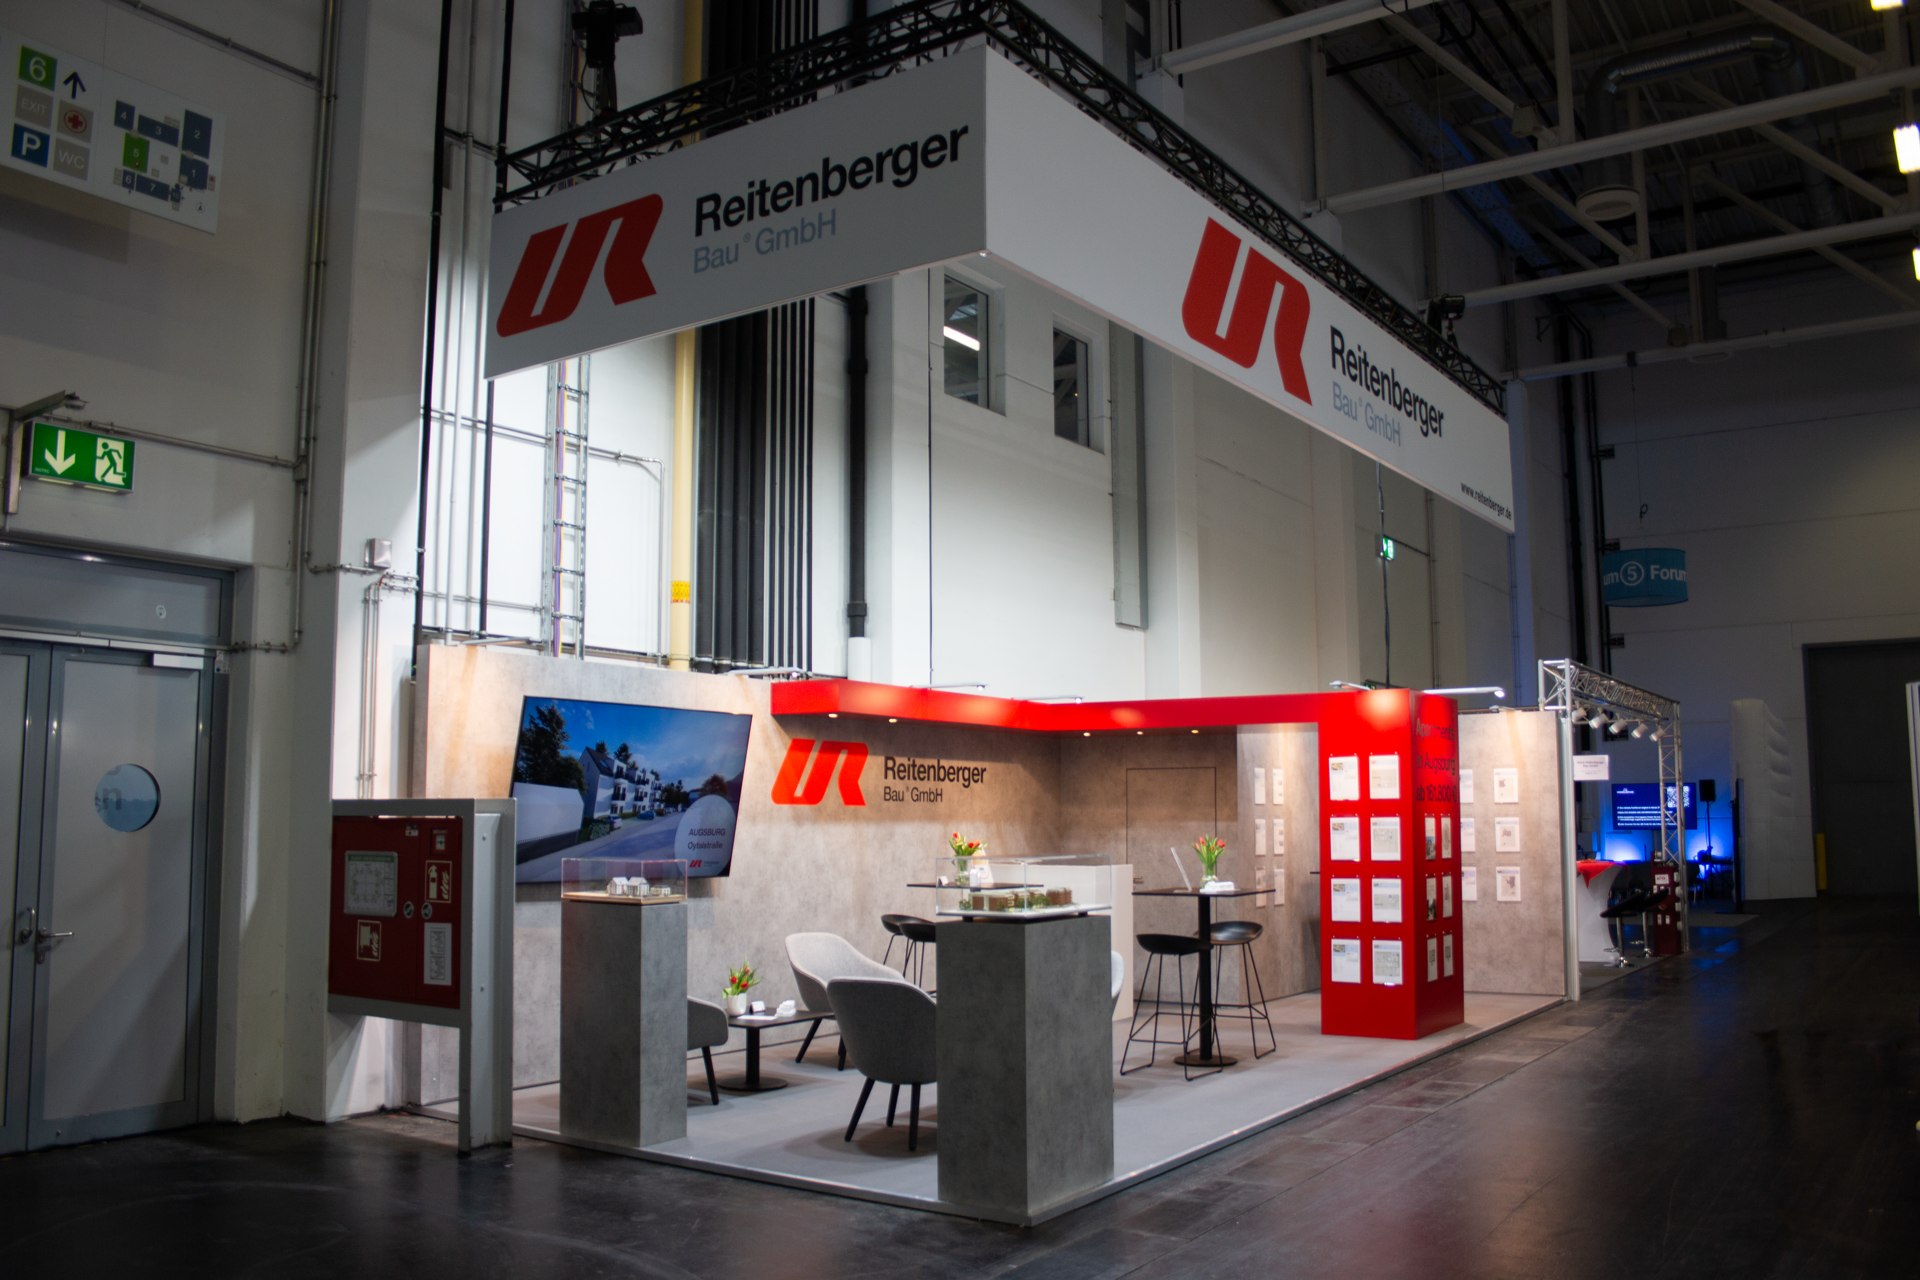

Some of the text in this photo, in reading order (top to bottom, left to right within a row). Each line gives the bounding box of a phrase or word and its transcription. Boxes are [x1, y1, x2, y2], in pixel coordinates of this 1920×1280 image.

[29, 57, 47, 82] 6
[21, 96, 48, 116] EXIT
[22, 132, 41, 156] P
[58, 150, 85, 170] WC
[694, 125, 969, 237] Reitenberger
[755, 208, 837, 255] GmbH
[1330, 324, 1444, 438] Reitenberger
[1364, 402, 1401, 447] GmbH
[1460, 482, 1512, 521] www.reitenberger.de
[1627, 565, 1638, 581] 5
[1416, 717, 1455, 741] Apartments
[884, 756, 987, 789] Reitenberger
[1424, 752, 1456, 776] Augsburg
[910, 787, 943, 803] GmbH
[1416, 784, 1425, 802] ab
[688, 828, 725, 836] AUGSBURG
